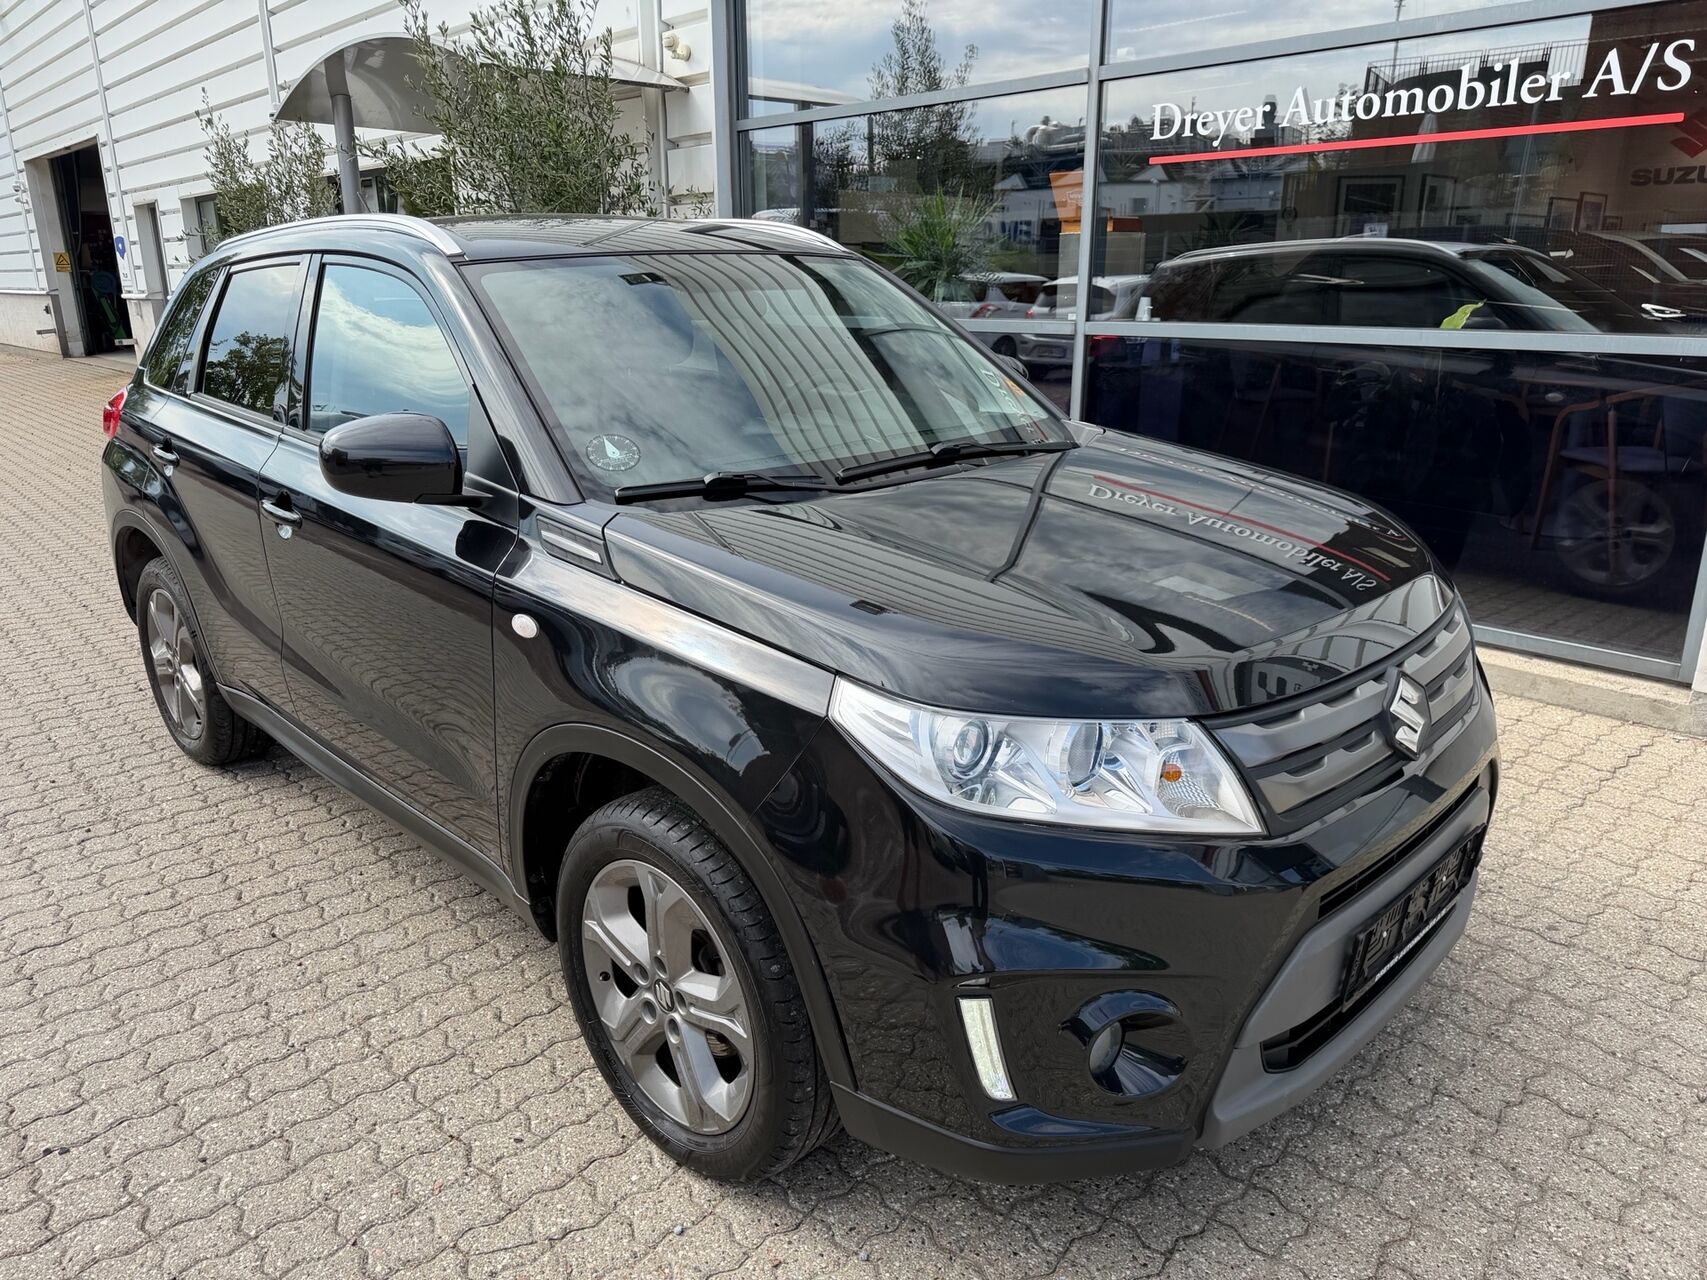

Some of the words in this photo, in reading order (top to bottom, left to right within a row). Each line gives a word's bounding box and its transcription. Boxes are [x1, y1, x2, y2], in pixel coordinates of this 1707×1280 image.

[1149, 102, 1270, 148] Dreyer
[1278, 57, 1571, 128] Automobiler
[1583, 39, 1696, 98] A/S
